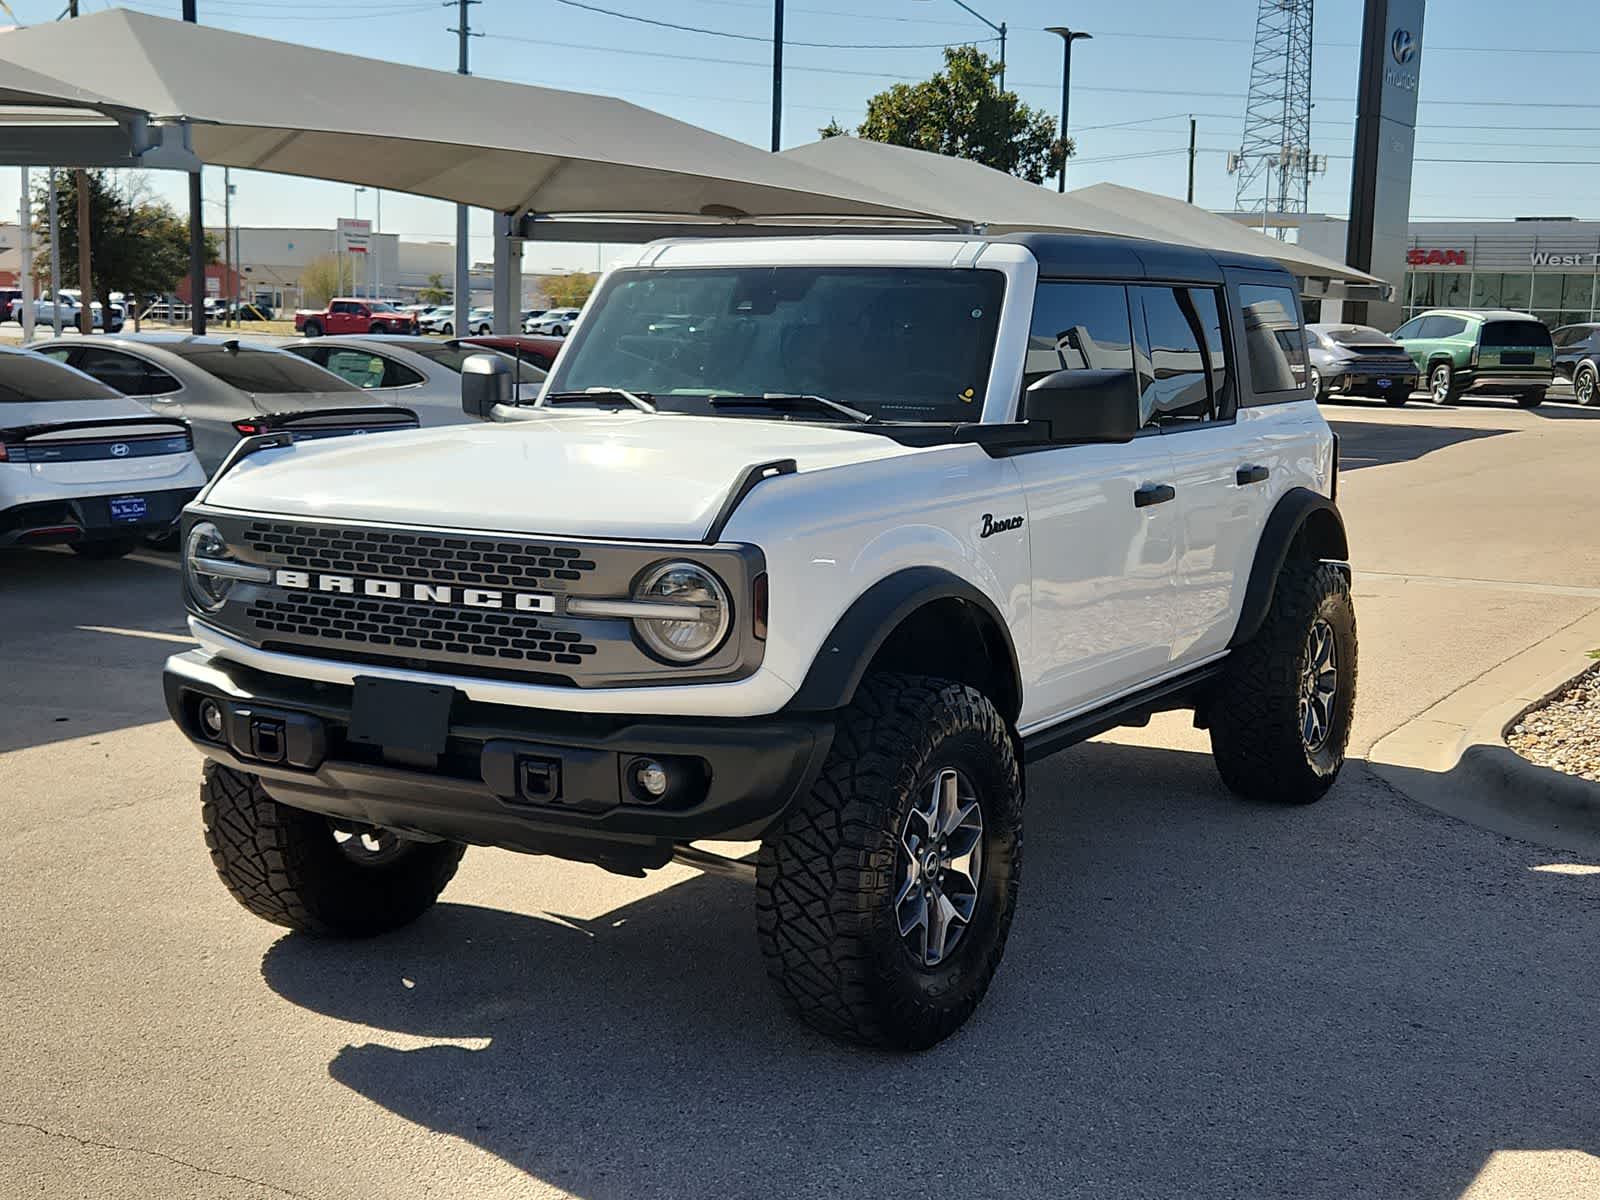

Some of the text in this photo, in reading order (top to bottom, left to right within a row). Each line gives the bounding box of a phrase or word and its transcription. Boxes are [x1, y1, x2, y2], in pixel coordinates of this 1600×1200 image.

[1530, 253, 1581, 266] West
[980, 513, 1024, 538] Bronco
[276, 569, 556, 613] BRONCO
